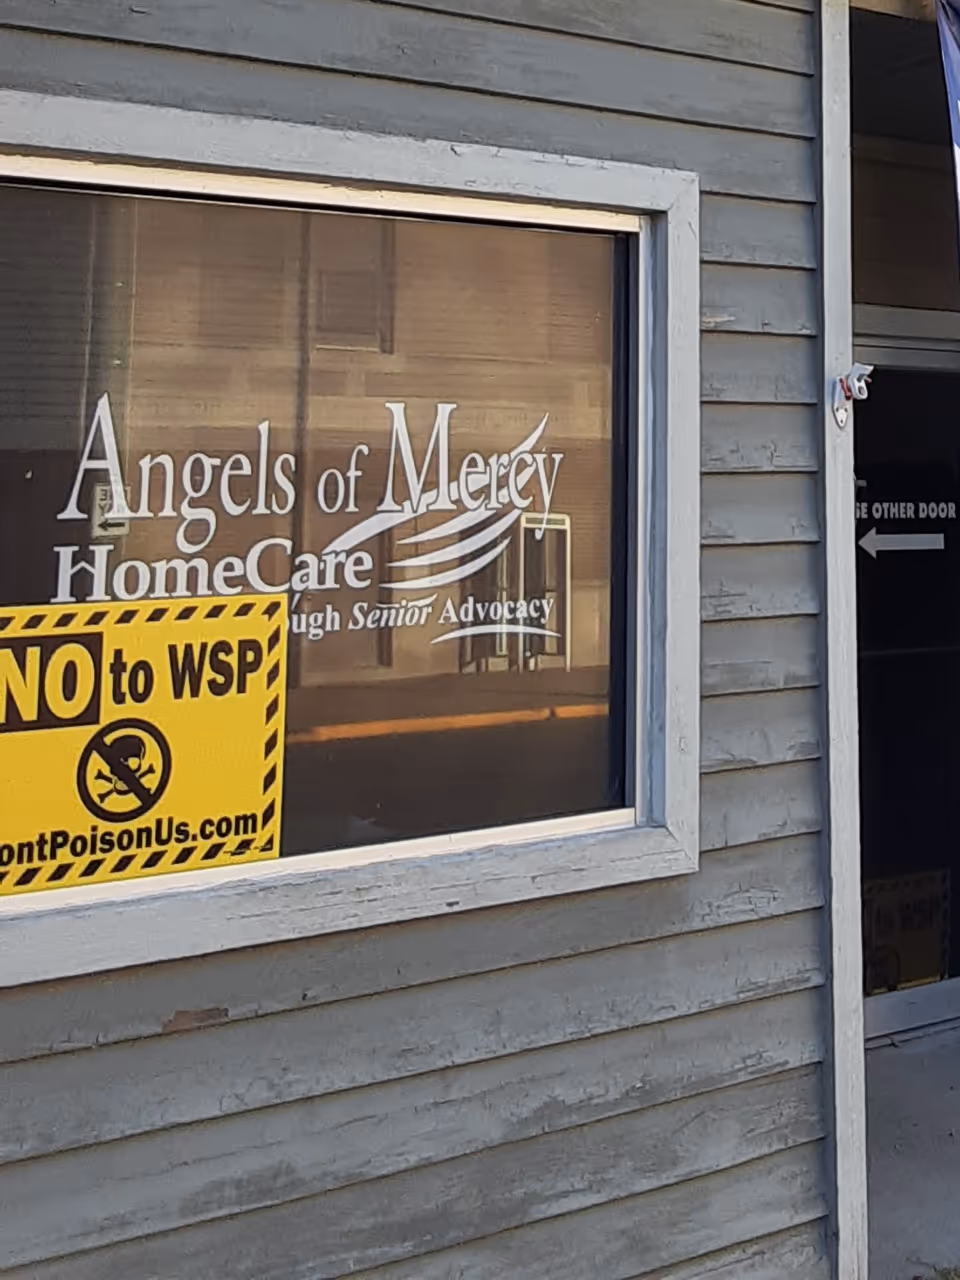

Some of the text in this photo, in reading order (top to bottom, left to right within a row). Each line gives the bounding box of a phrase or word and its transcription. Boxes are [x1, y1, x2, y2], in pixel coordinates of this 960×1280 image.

[56, 392, 565, 555] Angels of Mercy
[872, 501, 915, 519] OTHER
[918, 501, 957, 519] DOOR
[51, 537, 373, 604] HomeCare
[286, 596, 556, 640] ugh Senior Advocacy
[0, 639, 264, 724] NO to WSP
